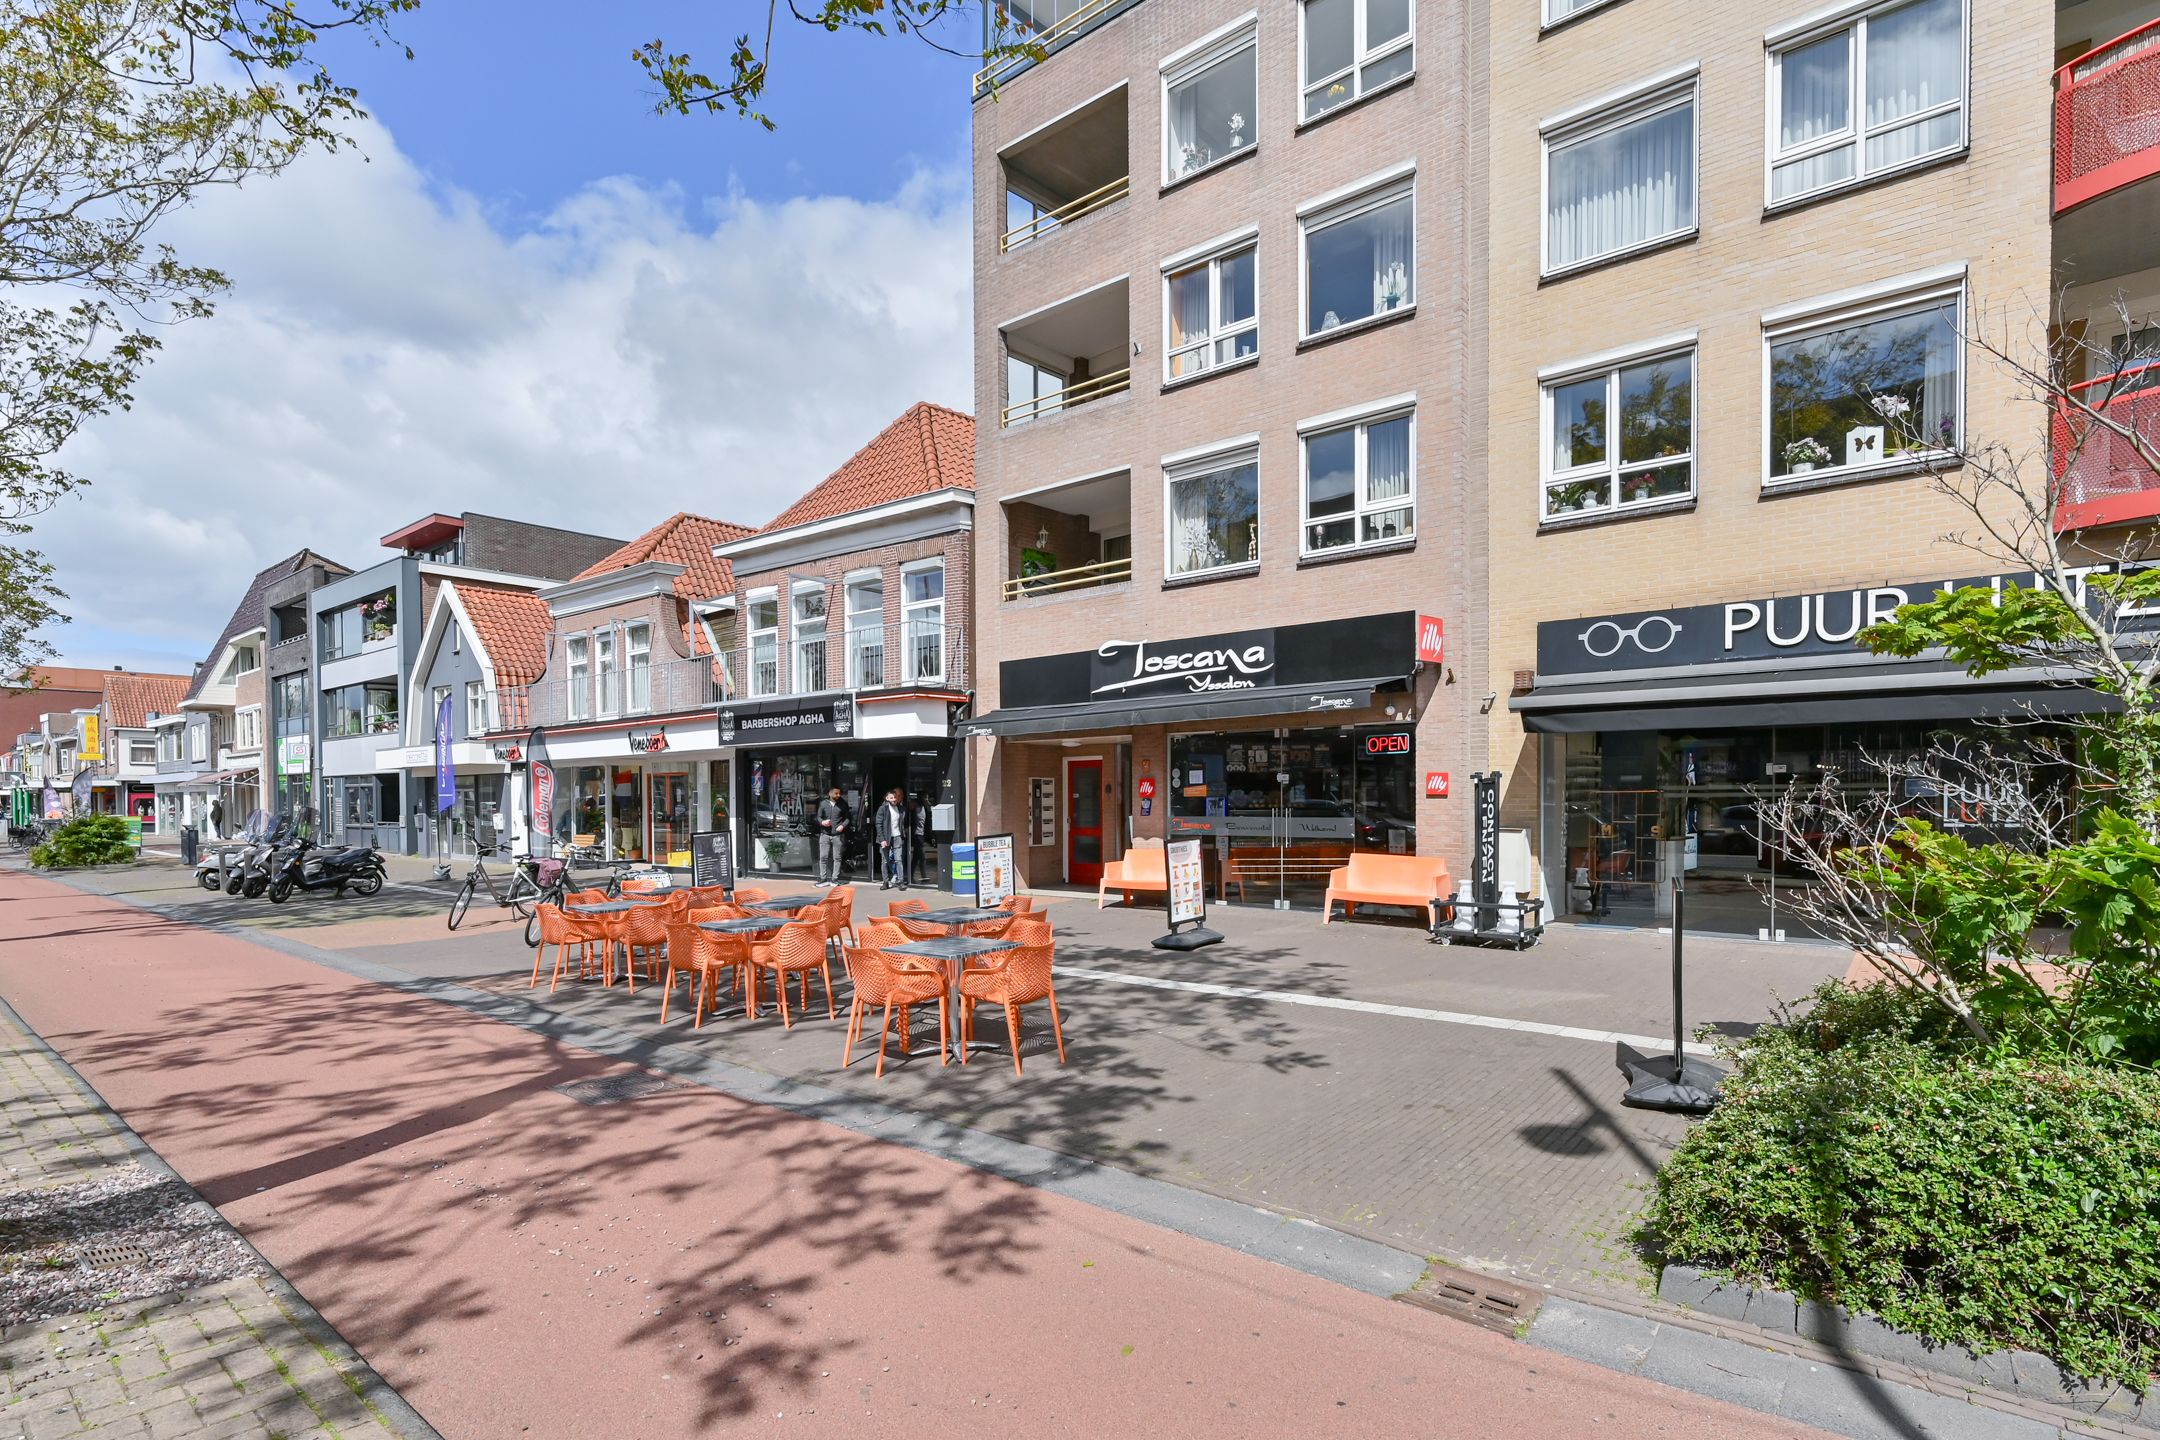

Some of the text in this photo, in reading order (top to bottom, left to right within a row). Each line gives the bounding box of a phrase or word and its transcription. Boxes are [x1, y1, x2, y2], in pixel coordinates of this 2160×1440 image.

[1724, 587, 1909, 651] PUUR
[1421, 623, 1443, 657] illy
[1098, 639, 1275, 679] Toscana
[1184, 674, 1255, 692] Yssalon
[741, 713, 825, 730] BARBERSHOP AGHA
[1367, 735, 1409, 753] OPEN
[1139, 781, 1153, 796] illy
[1428, 775, 1447, 792] illy
[534, 777, 550, 831] Coleman
[773, 793, 803, 816] AGHA
[1487, 789, 1495, 884] CONTACT
